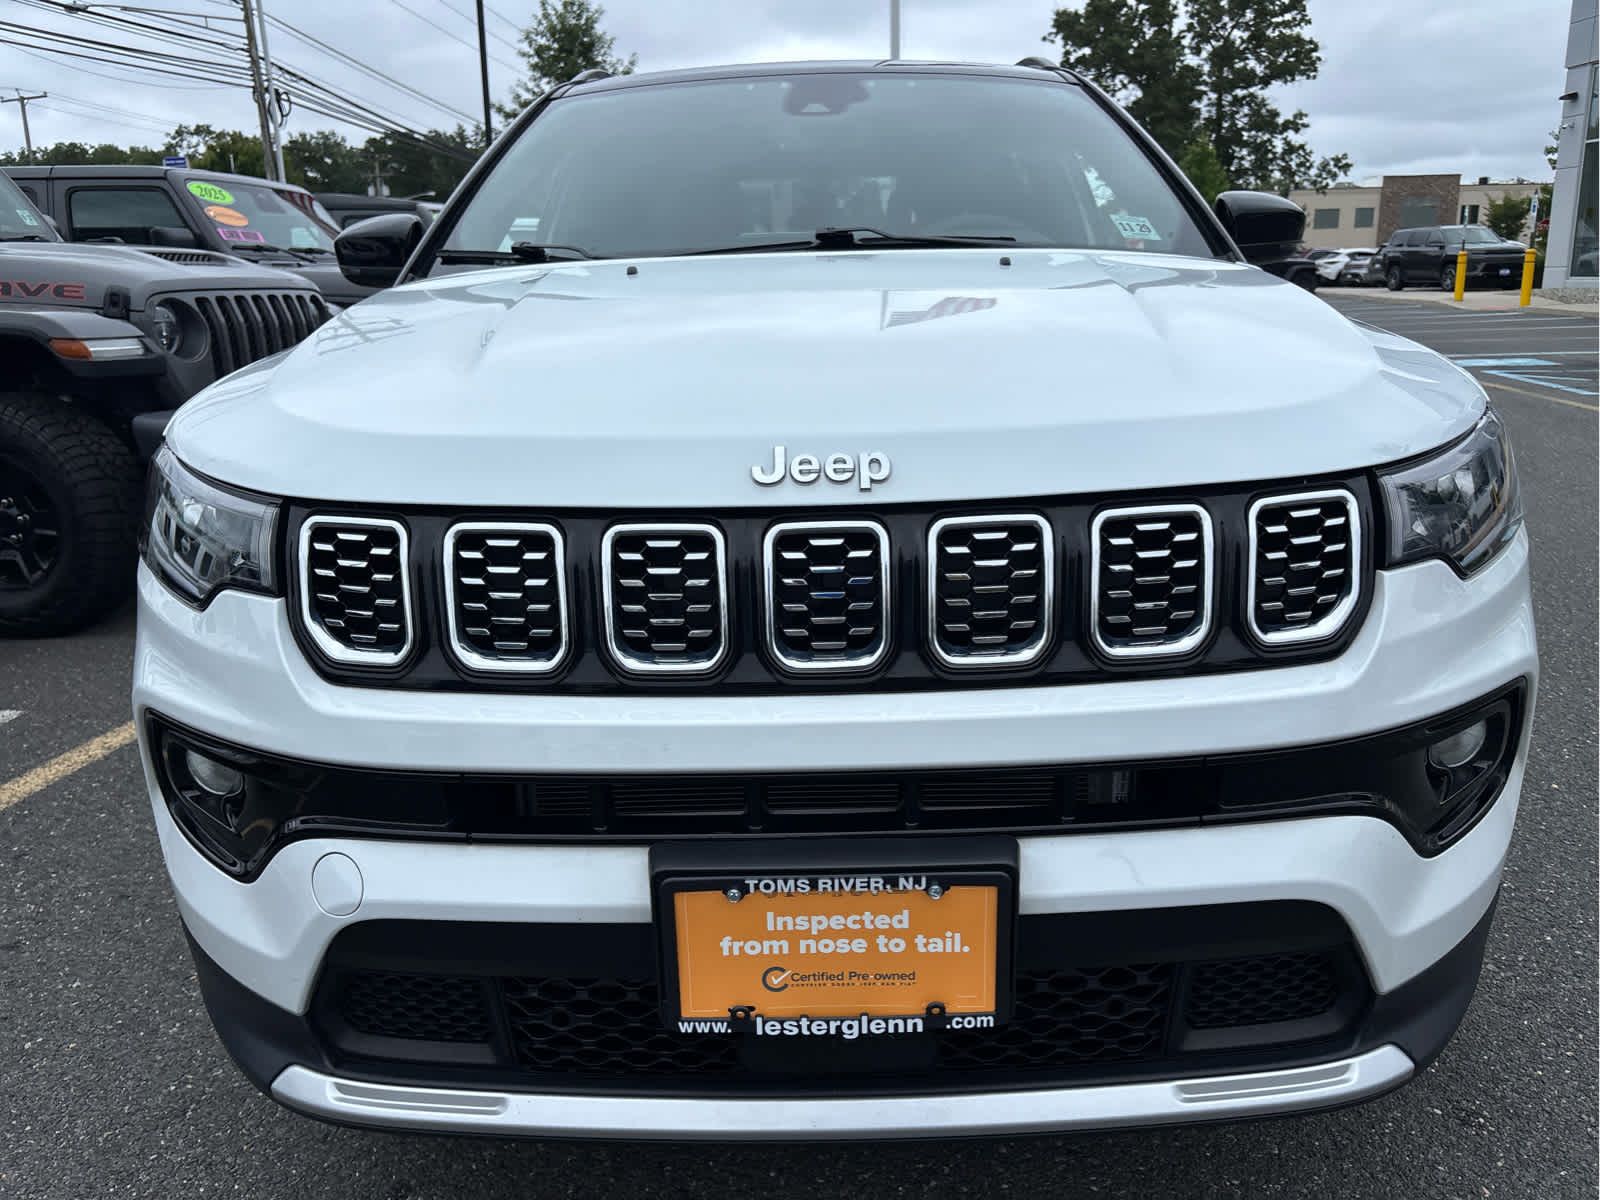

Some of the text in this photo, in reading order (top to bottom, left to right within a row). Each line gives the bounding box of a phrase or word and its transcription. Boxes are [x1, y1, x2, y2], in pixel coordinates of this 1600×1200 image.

[196, 185, 226, 201] 2025
[751, 445, 892, 492] Jeep
[744, 879, 811, 893] TOMS
[899, 876, 927, 890] NJ
[766, 909, 911, 936] Inspected
[719, 930, 971, 956] from nose to tail.
[790, 970, 917, 983] Certified Pre-owned
[678, 1014, 995, 1040] www. lesterglenn .com
